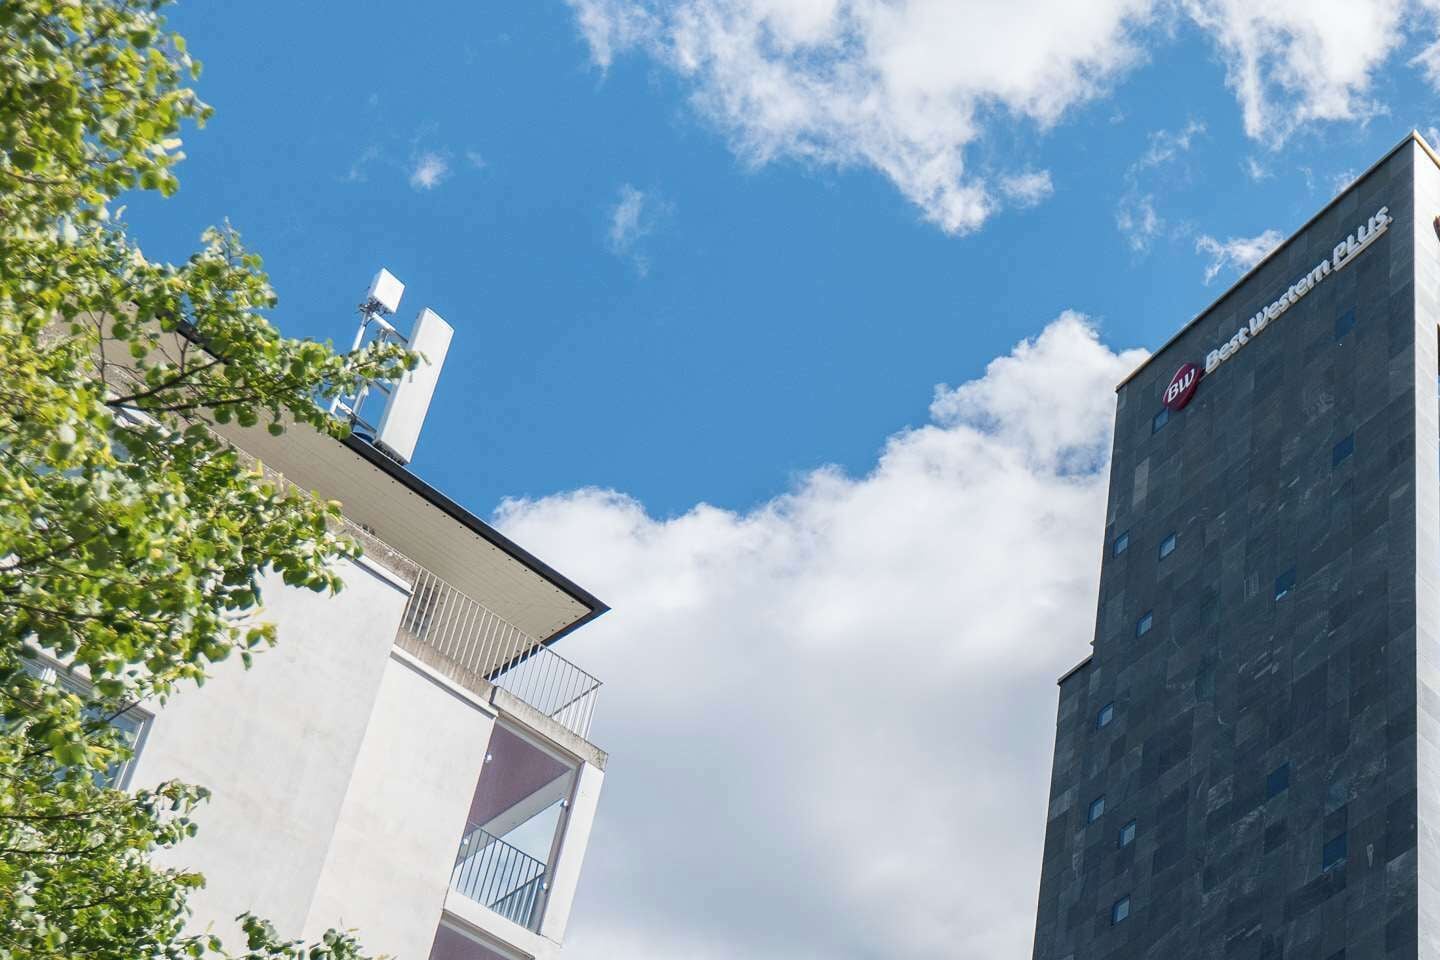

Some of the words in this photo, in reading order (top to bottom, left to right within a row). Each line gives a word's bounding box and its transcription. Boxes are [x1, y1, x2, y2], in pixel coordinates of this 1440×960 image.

[1167, 367, 1195, 403] BW
[1205, 327, 1249, 373] Best
[1249, 259, 1330, 336] Western
[1333, 206, 1389, 267] PLUS
